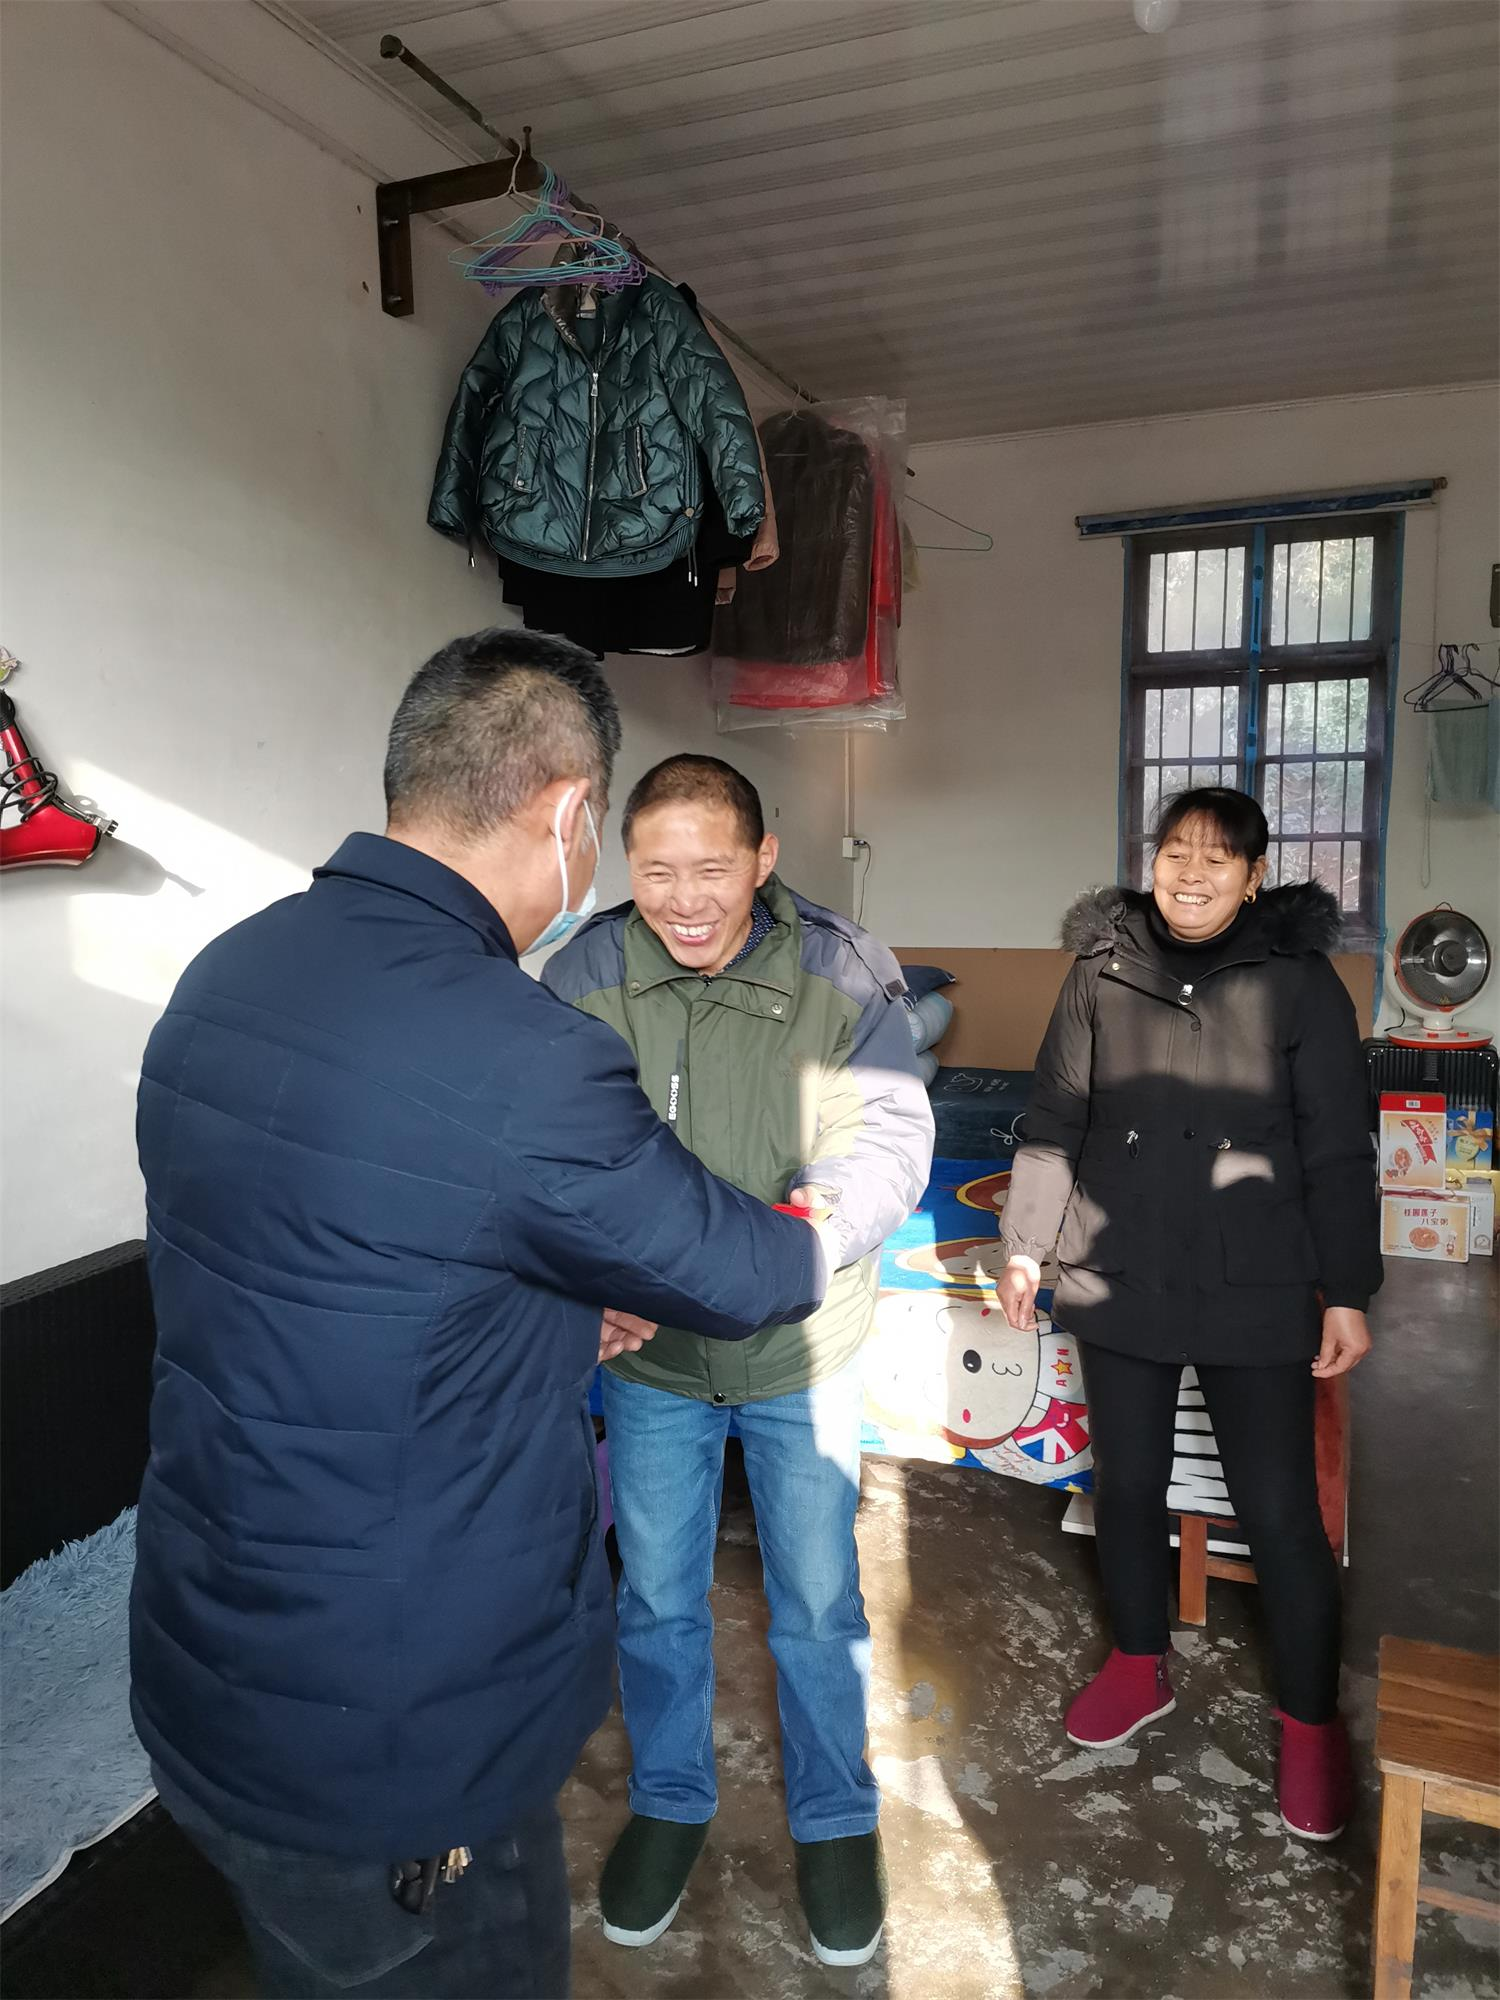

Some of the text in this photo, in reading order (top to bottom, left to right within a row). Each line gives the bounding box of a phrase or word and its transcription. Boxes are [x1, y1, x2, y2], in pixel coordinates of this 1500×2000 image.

[668, 1074, 680, 1121] EGOOSS
[1421, 1218, 1449, 1226] 八宝粥
